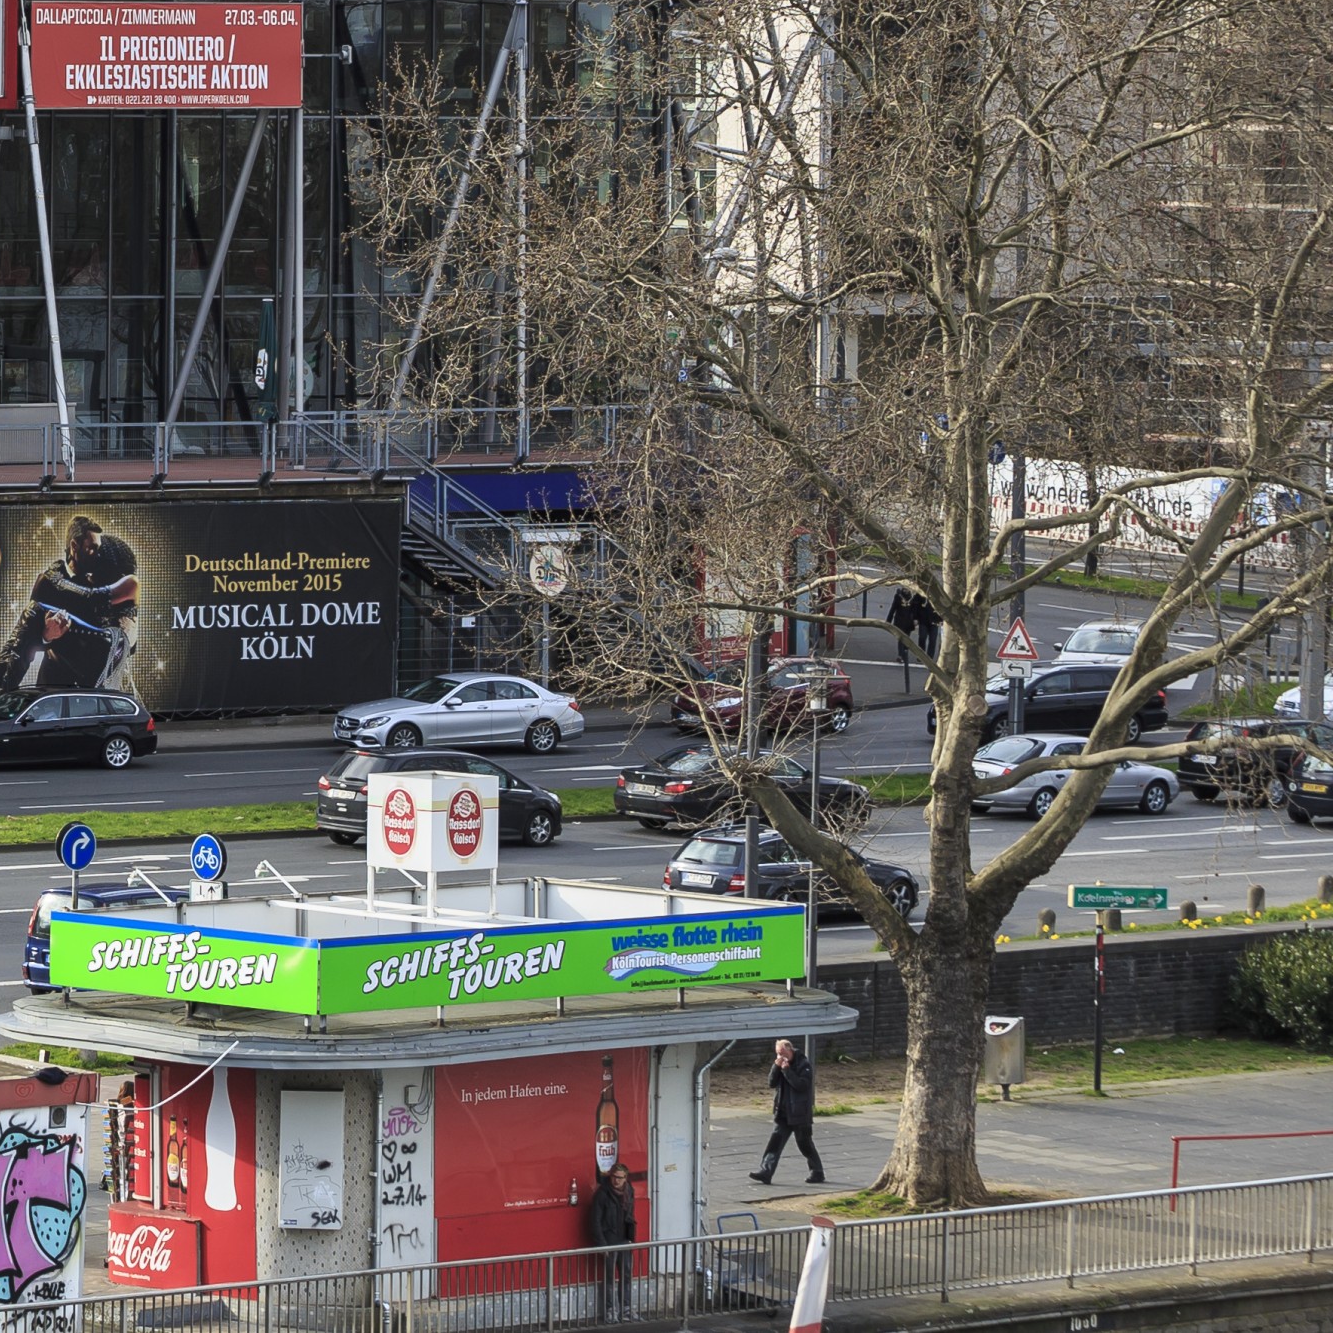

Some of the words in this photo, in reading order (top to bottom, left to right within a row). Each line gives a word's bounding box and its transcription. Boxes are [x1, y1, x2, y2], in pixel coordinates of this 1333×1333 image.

[36, 8, 112, 25] DALLAPICCOLA
[121, 9, 196, 25] ZIMMERMANN
[225, 9, 298, 26] 27.03.-06.04.
[100, 36, 115, 61] IL
[120, 36, 224, 61] PRIGIONIERO
[66, 65, 206, 90] EKKLESIASTISCHE
[211, 65, 268, 89] AKTION
[98, 95, 124, 104] KARTEN:
[181, 94, 250, 104] WWW.OPERKOELN.COM
[185, 552, 371, 573] Deutschland-Premiere
[213, 573, 298, 593] November
[303, 573, 343, 593] 2015
[171, 603, 294, 629] MUSICAL
[300, 602, 381, 625] DOME
[240, 632, 315, 660] KÖLN
[449, 817, 481, 830] Reissdorf
[388, 830, 410, 846] Kölsch
[453, 831, 475, 845] Kölsch
[612, 929, 669, 951] weisse
[672, 925, 717, 947] flotte
[721, 921, 763, 944] rhein
[87, 930, 212, 972] SCHIFFS-
[165, 953, 278, 993] TOUREN
[362, 932, 495, 994] SCHIFFS-
[448, 940, 565, 999] TOUREN
[461, 1089, 473, 1102] In
[474, 1087, 507, 1105] jedem
[510, 1083, 542, 1098] Hafen
[544, 1082, 569, 1096] eine.
[599, 1144, 616, 1157] früh
[383, 1161, 412, 1184] WM
